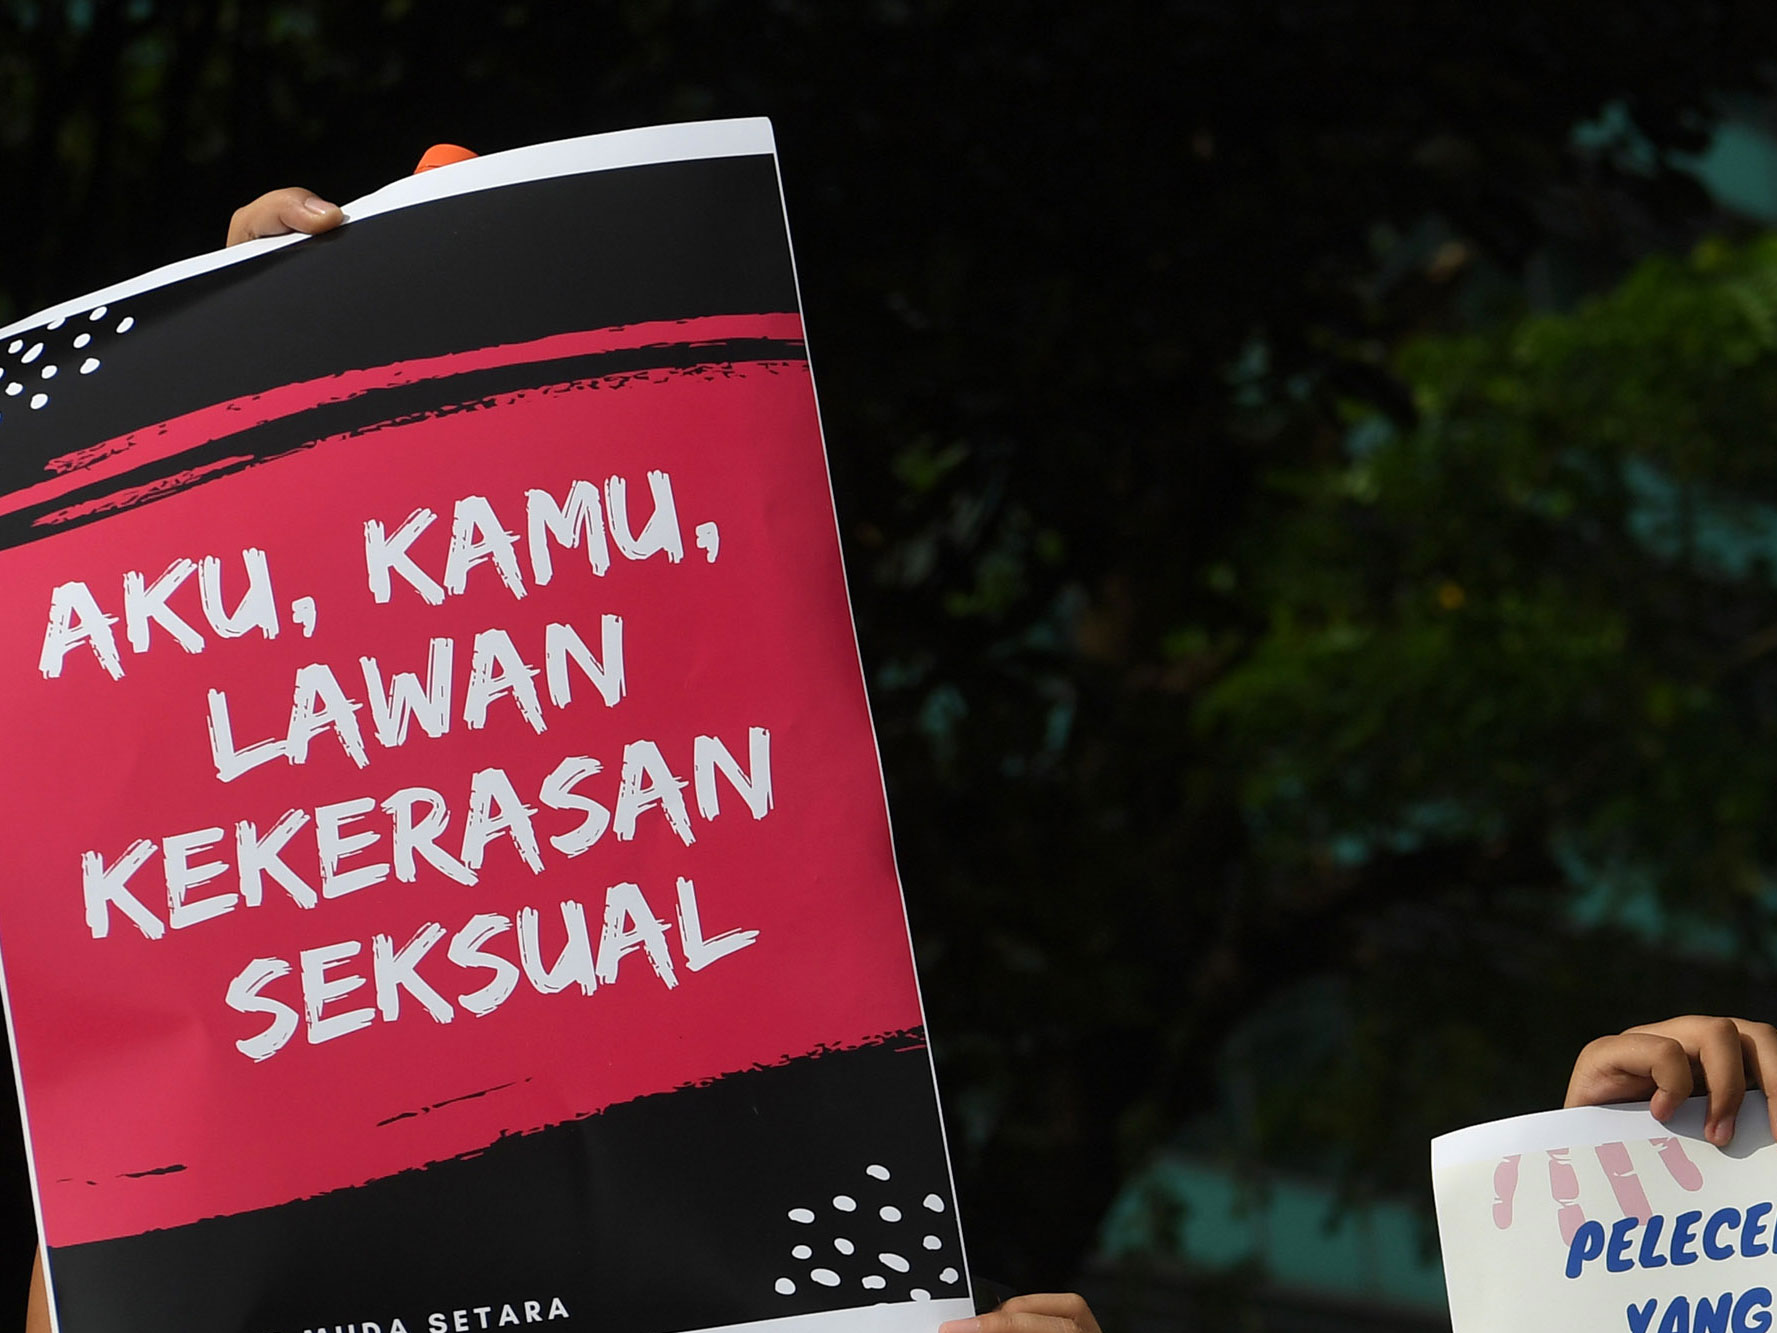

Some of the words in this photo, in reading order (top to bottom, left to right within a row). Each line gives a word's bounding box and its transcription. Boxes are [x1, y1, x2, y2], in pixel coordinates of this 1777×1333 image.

[38, 547, 318, 682] AKU,
[363, 469, 721, 606] KAMU,
[206, 613, 627, 783] LAWAN
[81, 725, 774, 940] KEKERASAN
[225, 876, 760, 1064] SEKSUAL
